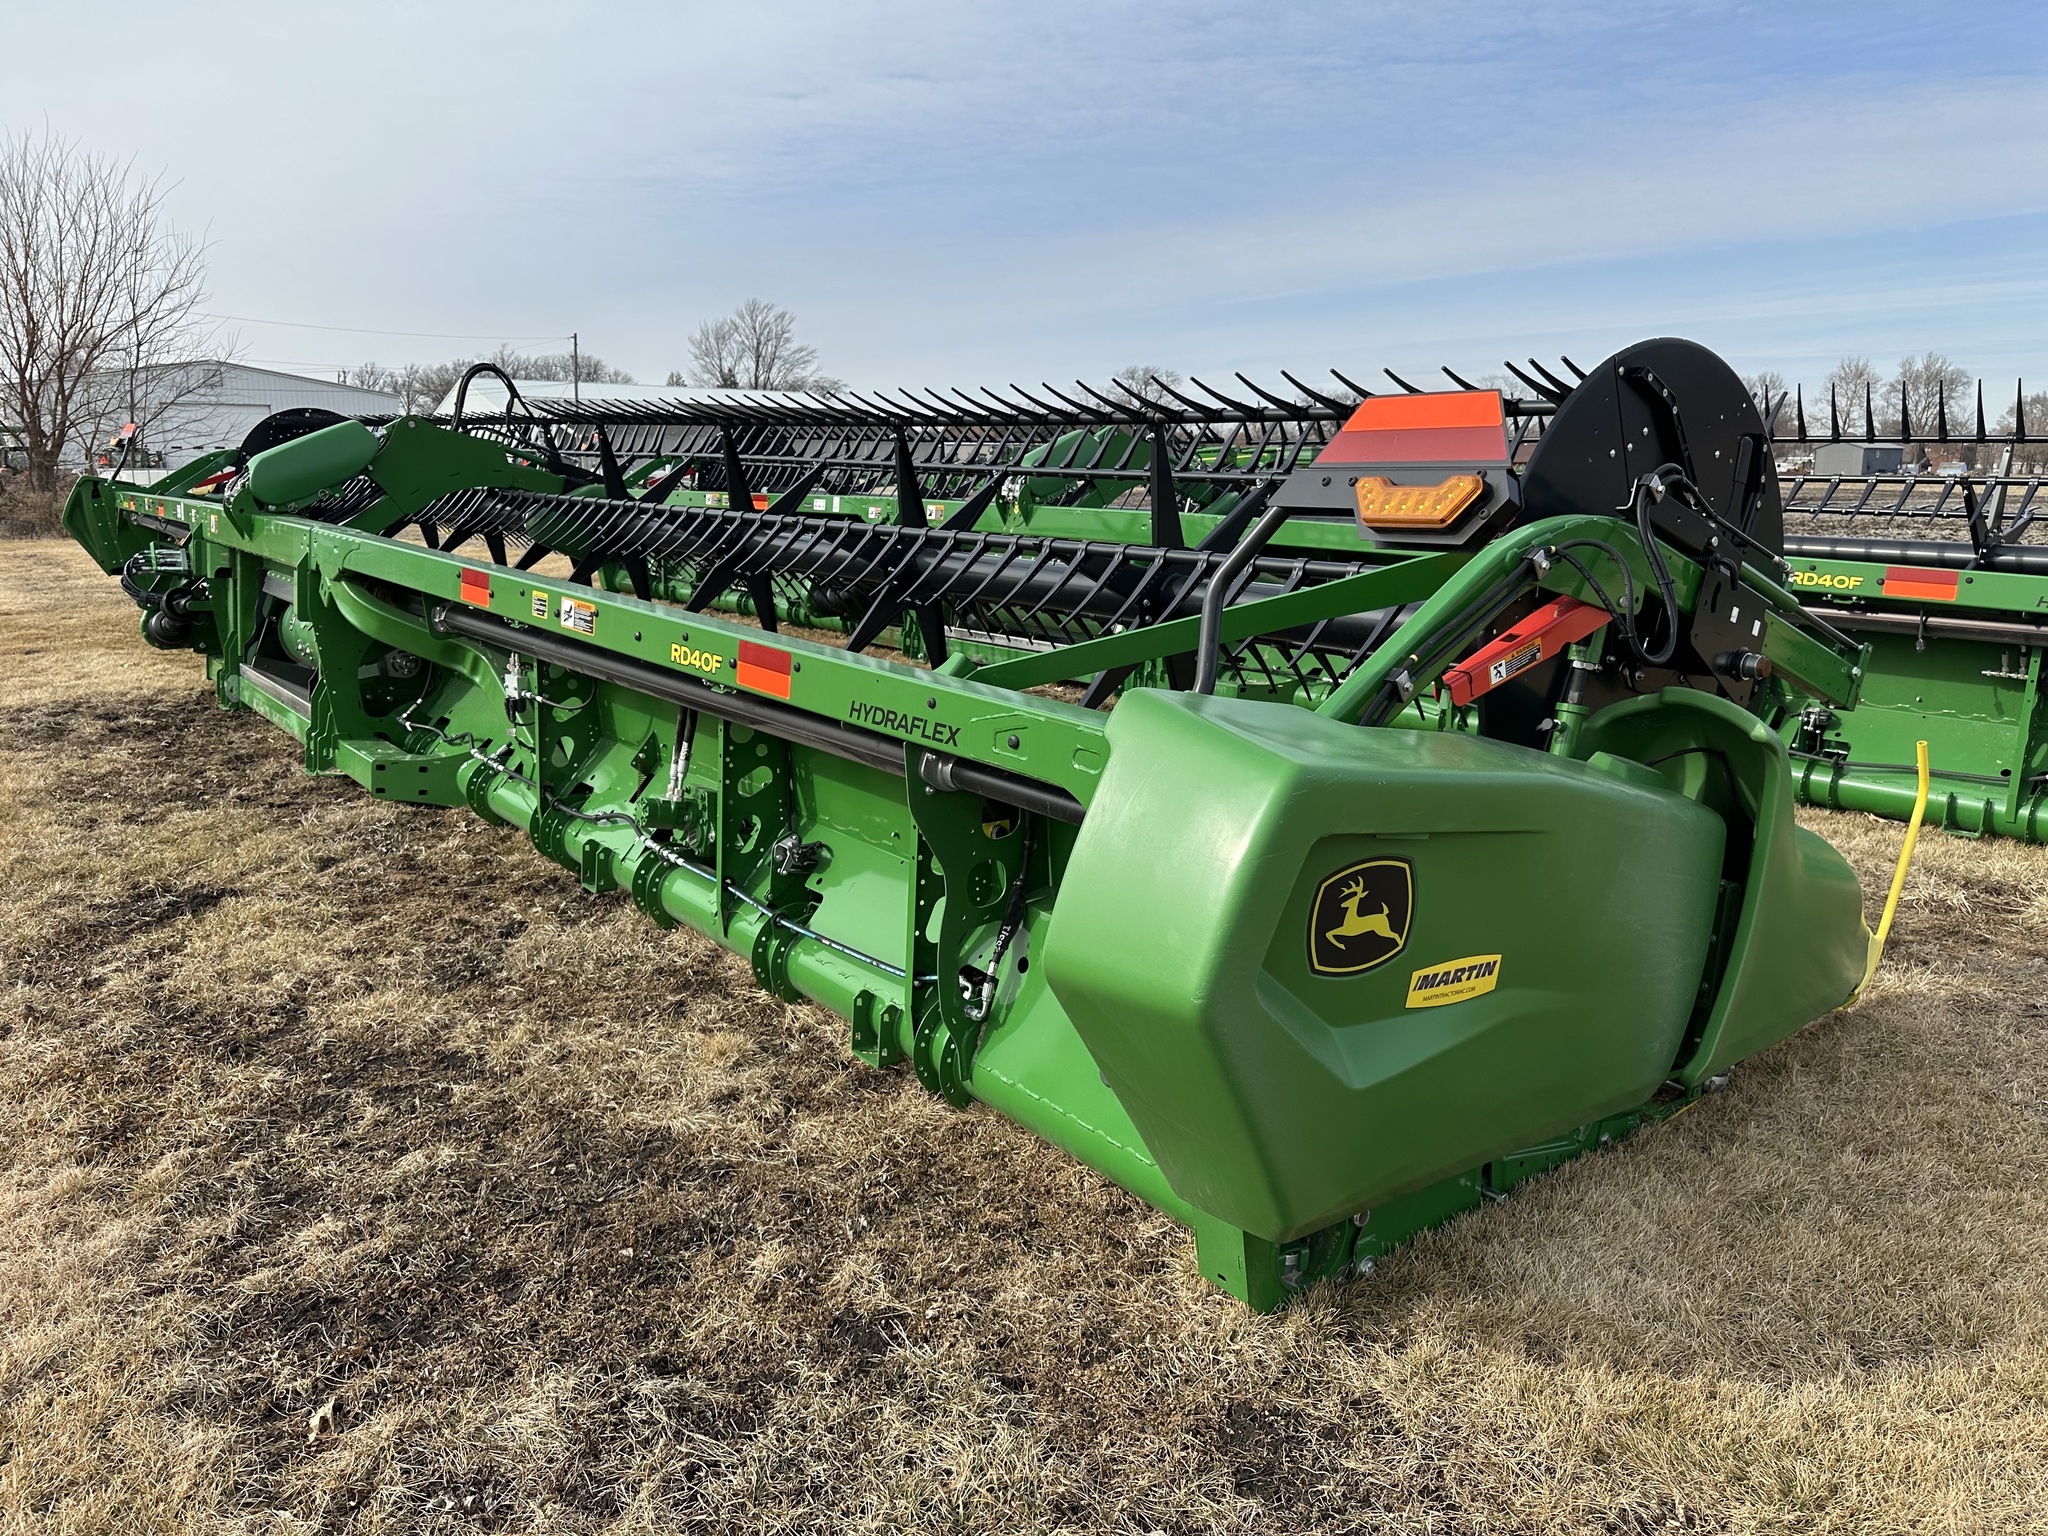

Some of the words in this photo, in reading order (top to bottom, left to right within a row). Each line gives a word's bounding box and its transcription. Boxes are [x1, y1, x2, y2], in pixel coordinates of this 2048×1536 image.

[1793, 571, 1864, 590] RD40F
[670, 642, 723, 675] RD40F
[849, 700, 961, 747] HYDRAFLEX
[1412, 960, 1498, 992] MARTIN
